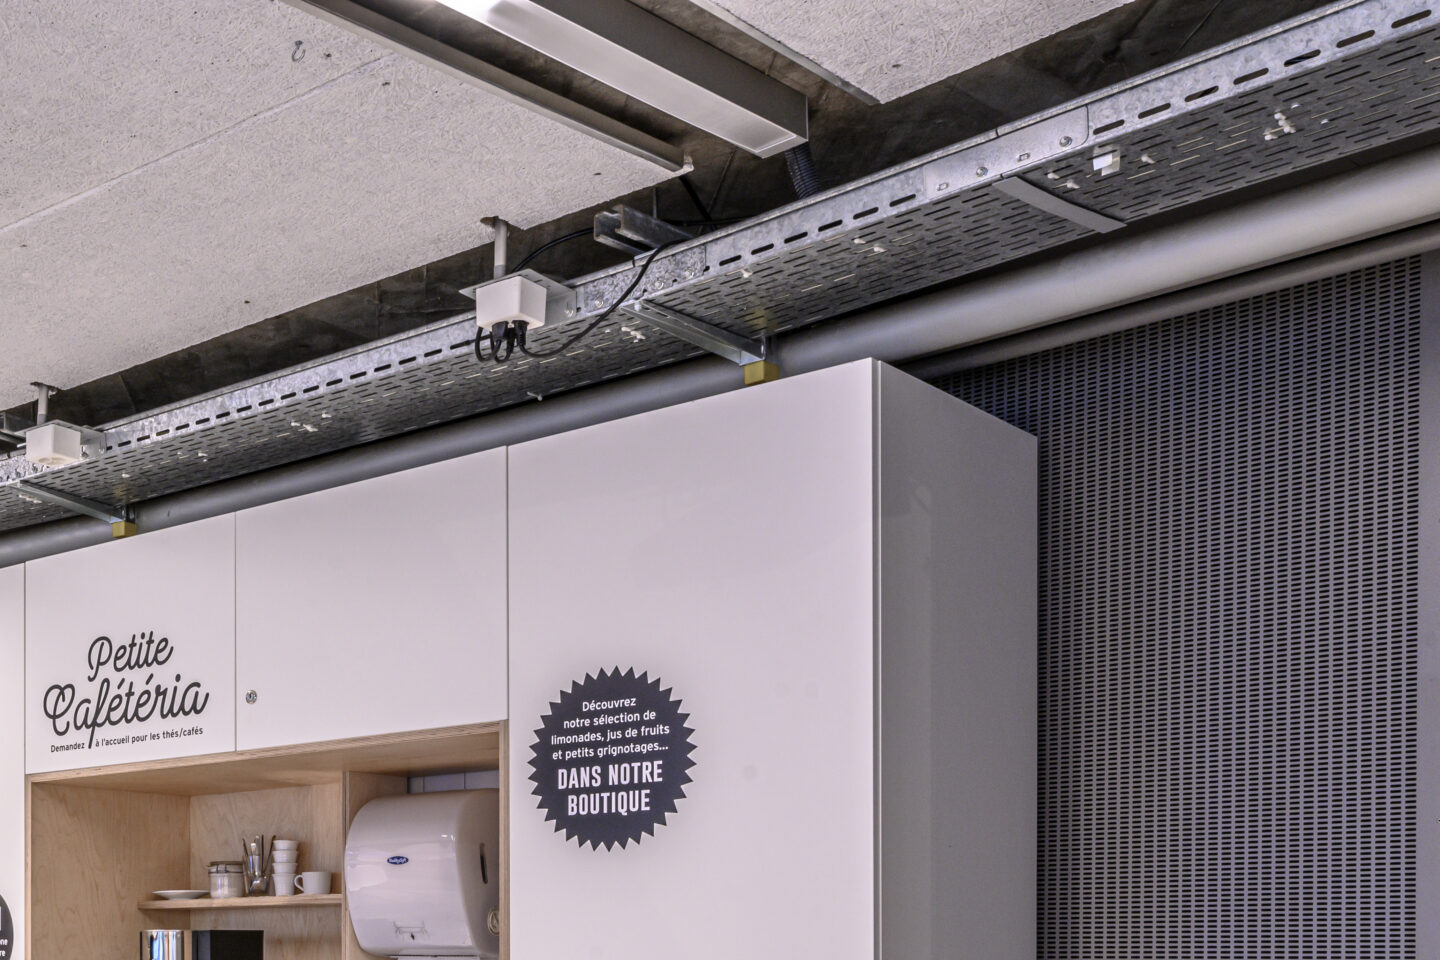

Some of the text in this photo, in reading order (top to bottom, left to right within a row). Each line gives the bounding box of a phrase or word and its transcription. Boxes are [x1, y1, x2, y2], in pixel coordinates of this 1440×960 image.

[87, 630, 174, 682] Petite
[43, 673, 210, 749] Cafétéria
[582, 698, 637, 712] Découvrez
[563, 710, 657, 729] notre sélection de
[50, 726, 204, 753] Demandez à l'accueil pour les thés/cafés
[551, 724, 670, 746] limonades, jus de fruits
[552, 742, 669, 761] et petits grignotages...
[558, 760, 663, 790] DANS NOTRE
[567, 789, 651, 816] BOUTIQUE
